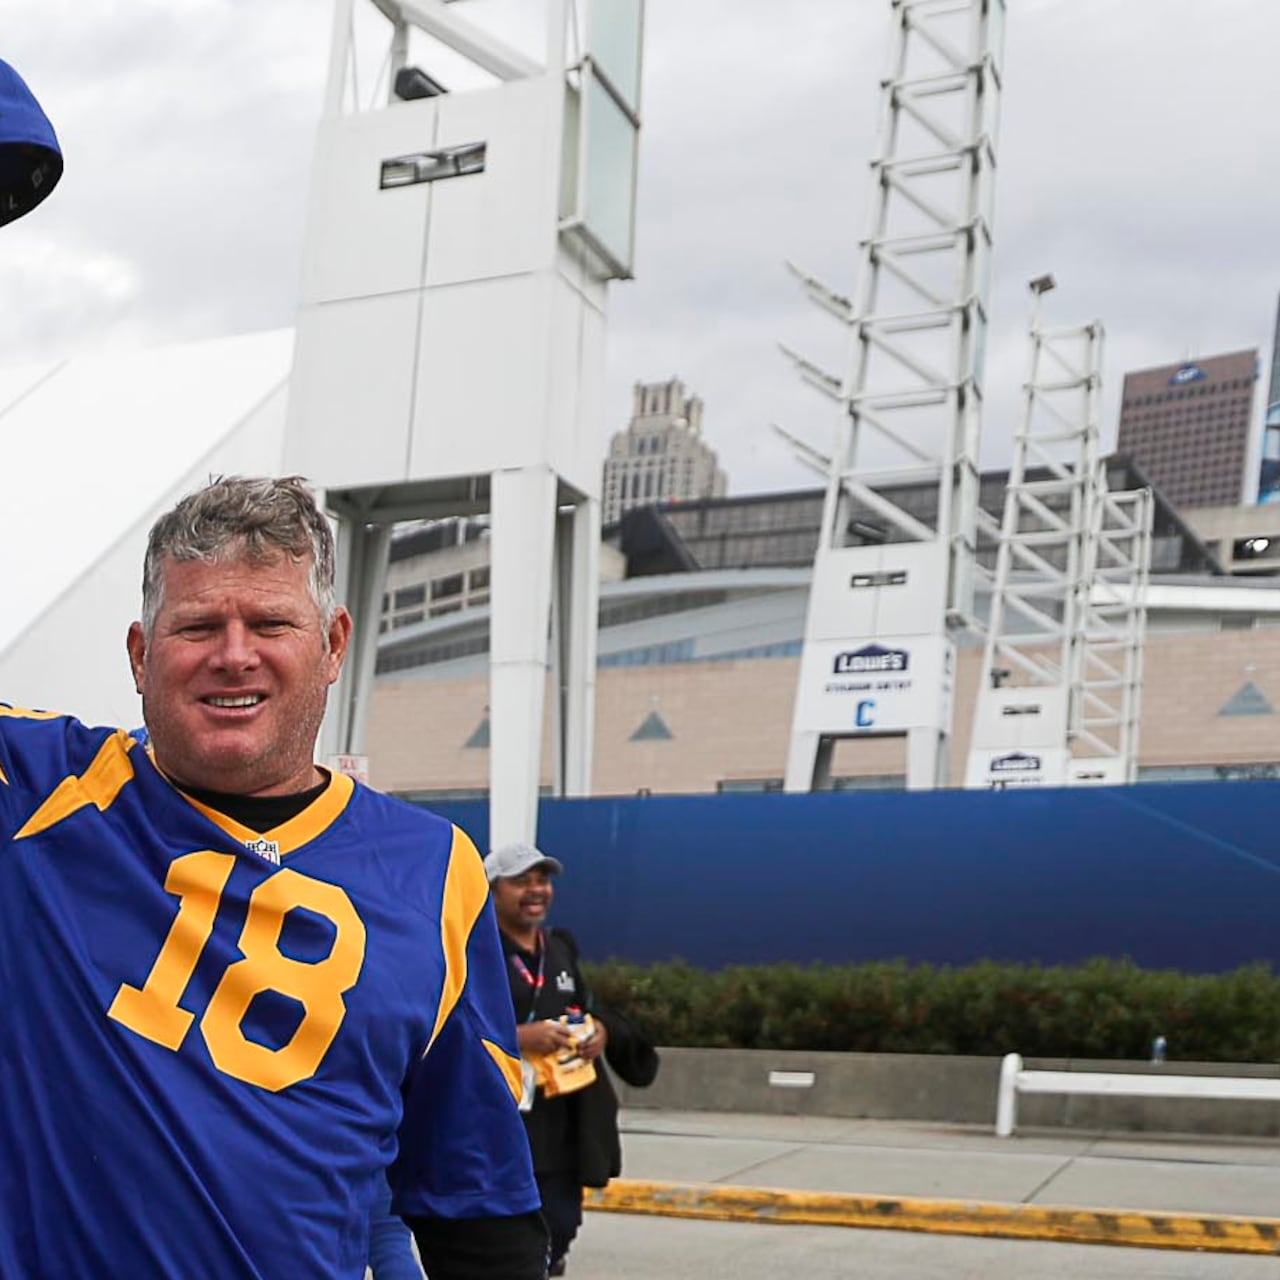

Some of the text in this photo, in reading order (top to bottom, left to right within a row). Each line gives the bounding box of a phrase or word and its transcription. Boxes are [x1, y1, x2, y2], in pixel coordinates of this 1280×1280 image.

[838, 653, 904, 672] LOWE'S
[855, 700, 875, 727] C
[107, 850, 367, 1092] 18
